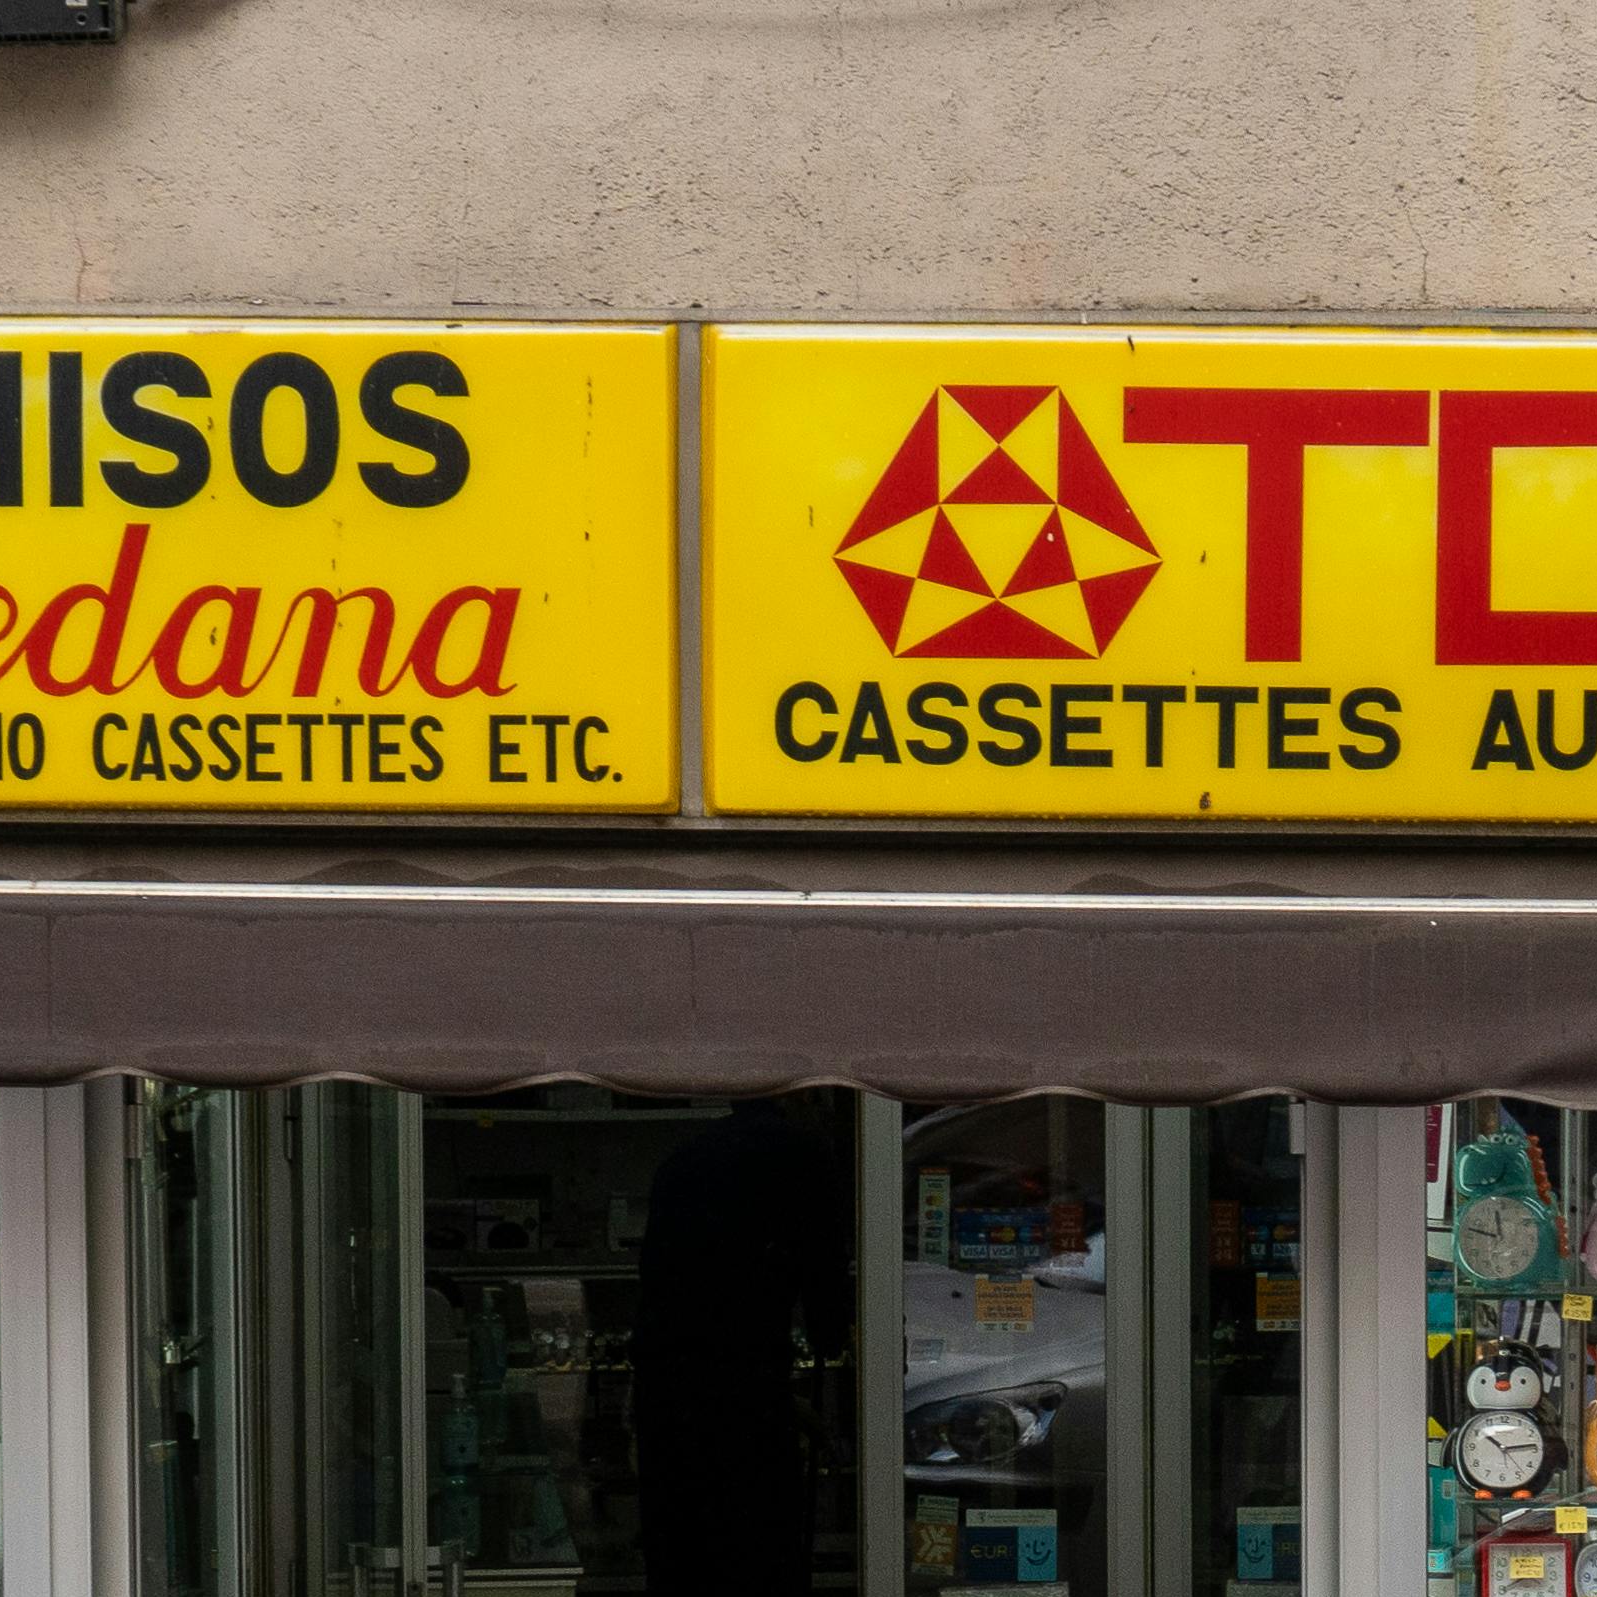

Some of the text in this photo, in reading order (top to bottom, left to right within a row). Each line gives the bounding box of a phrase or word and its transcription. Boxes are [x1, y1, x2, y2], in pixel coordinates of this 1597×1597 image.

[93, 714, 443, 782] CASSETTES
[490, 715, 624, 784] ETC.
[775, 682, 1401, 770] CASSETTES
